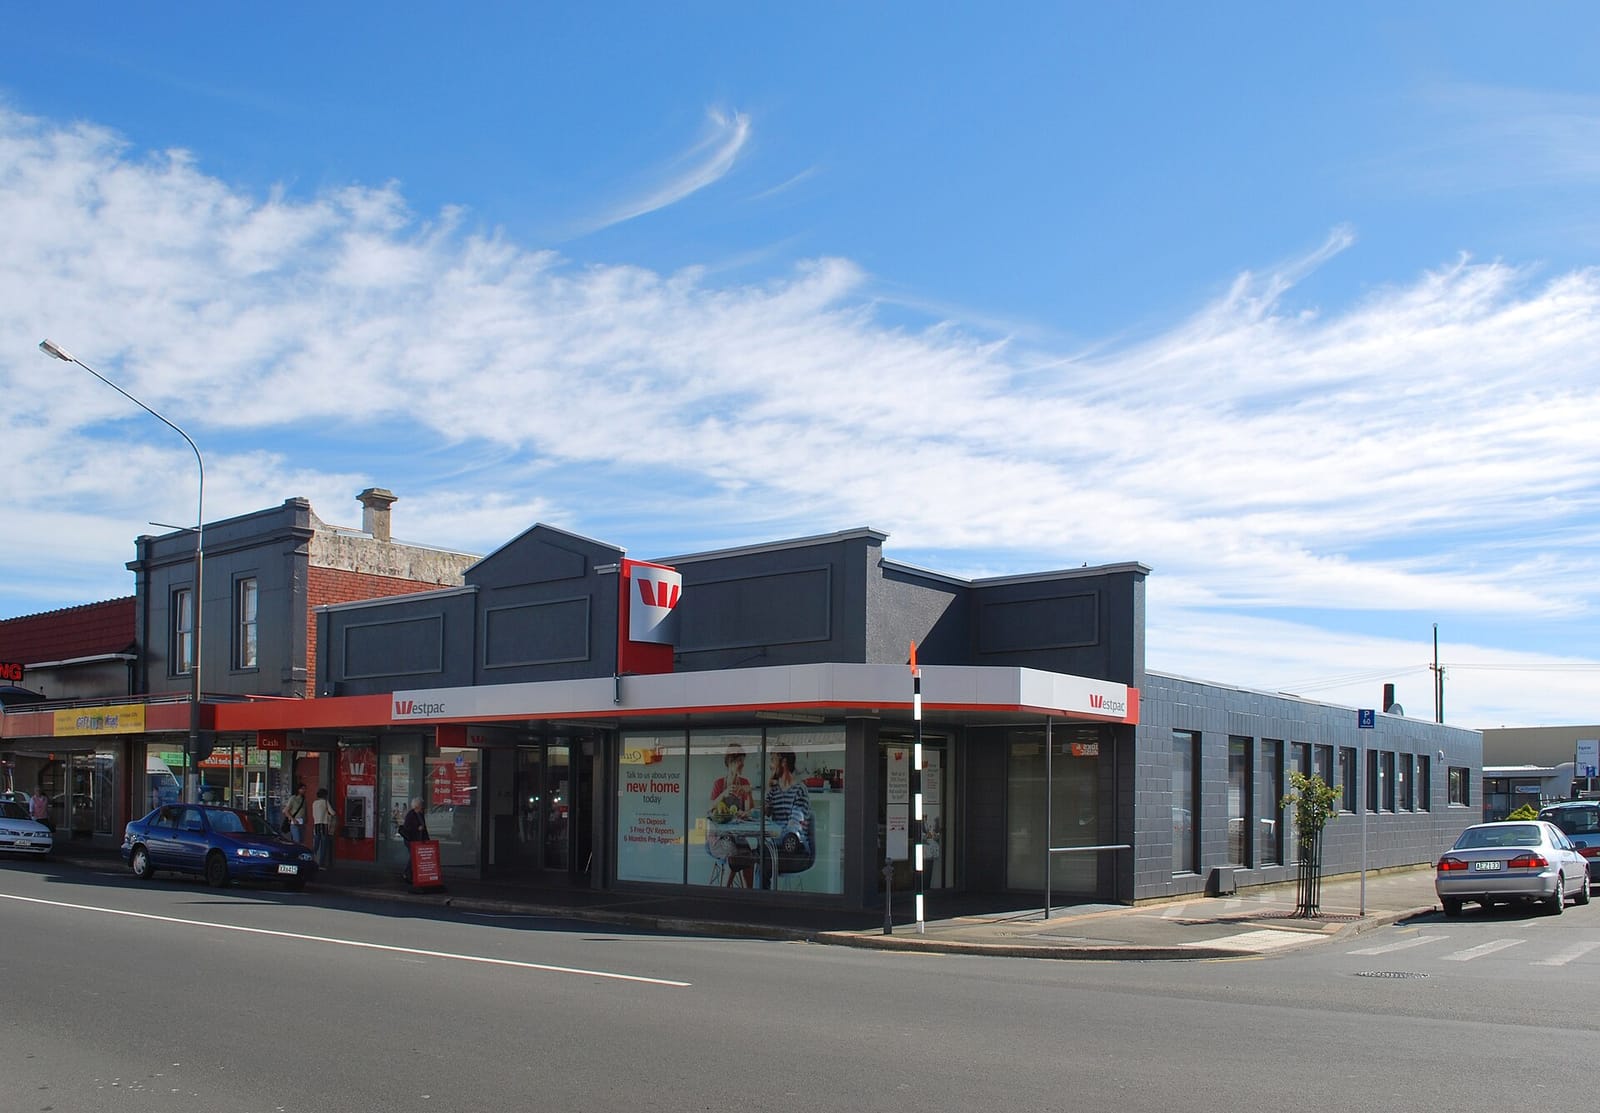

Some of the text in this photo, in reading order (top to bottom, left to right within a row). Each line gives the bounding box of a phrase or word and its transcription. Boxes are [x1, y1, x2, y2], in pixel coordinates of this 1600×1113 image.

[395, 700, 446, 716] Westpac
[1089, 694, 1125, 712] Westpac
[637, 771, 643, 779] to
[652, 771, 667, 779] about
[627, 779, 680, 793] new home
[643, 794, 661, 804] today
[646, 818, 666, 826] Deposit
[655, 827, 675, 835] Reports
